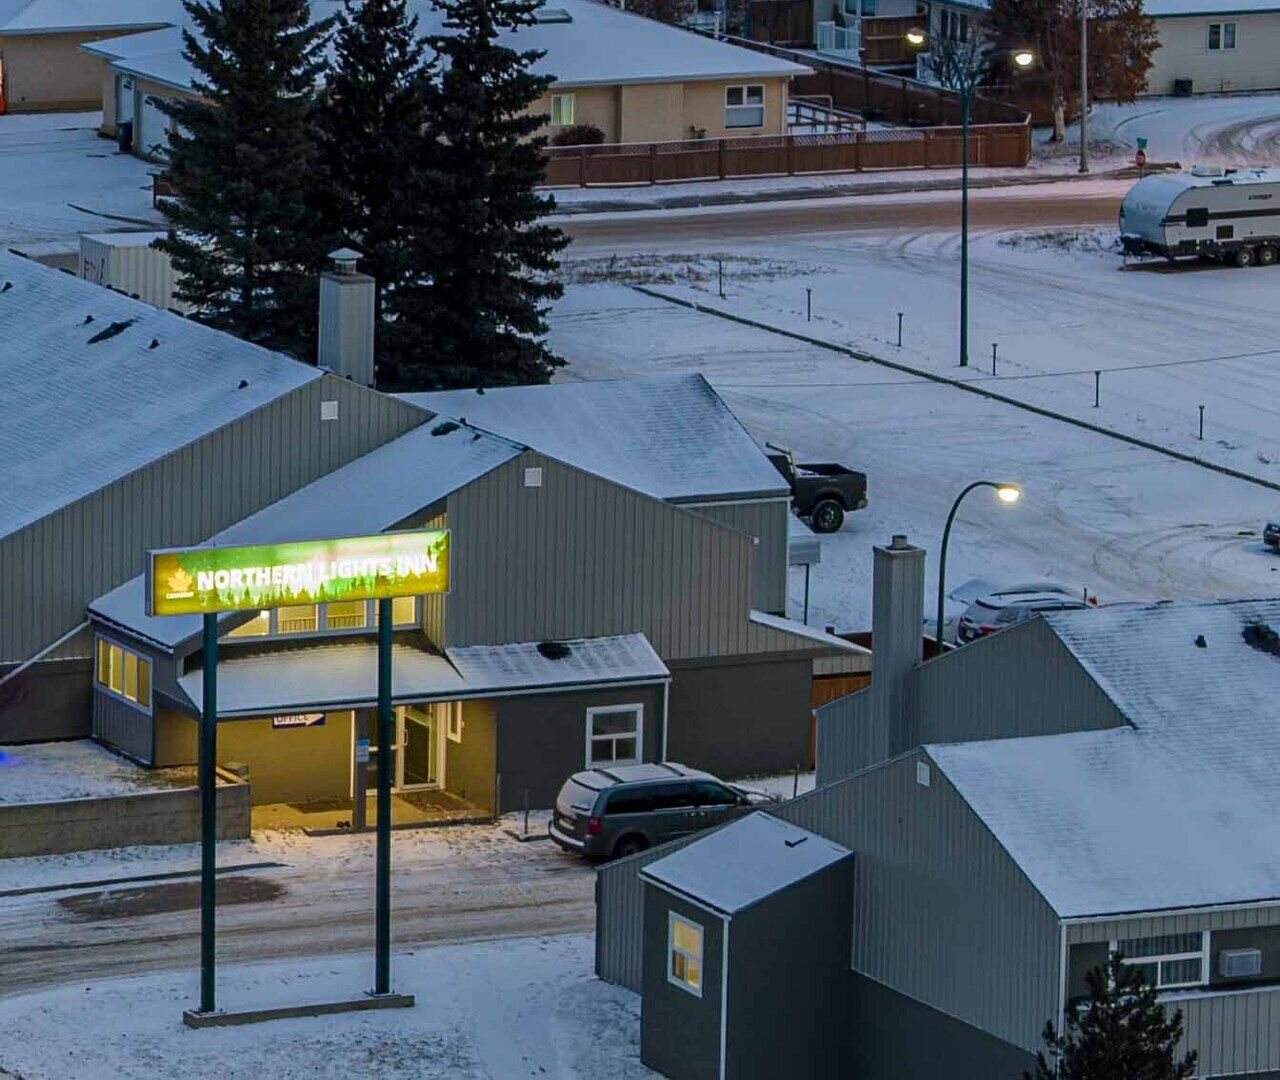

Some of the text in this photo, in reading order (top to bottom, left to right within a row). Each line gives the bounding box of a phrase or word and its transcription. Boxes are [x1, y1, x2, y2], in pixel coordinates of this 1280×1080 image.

[197, 554, 437, 590] NORTHERN LIGHTS INN
